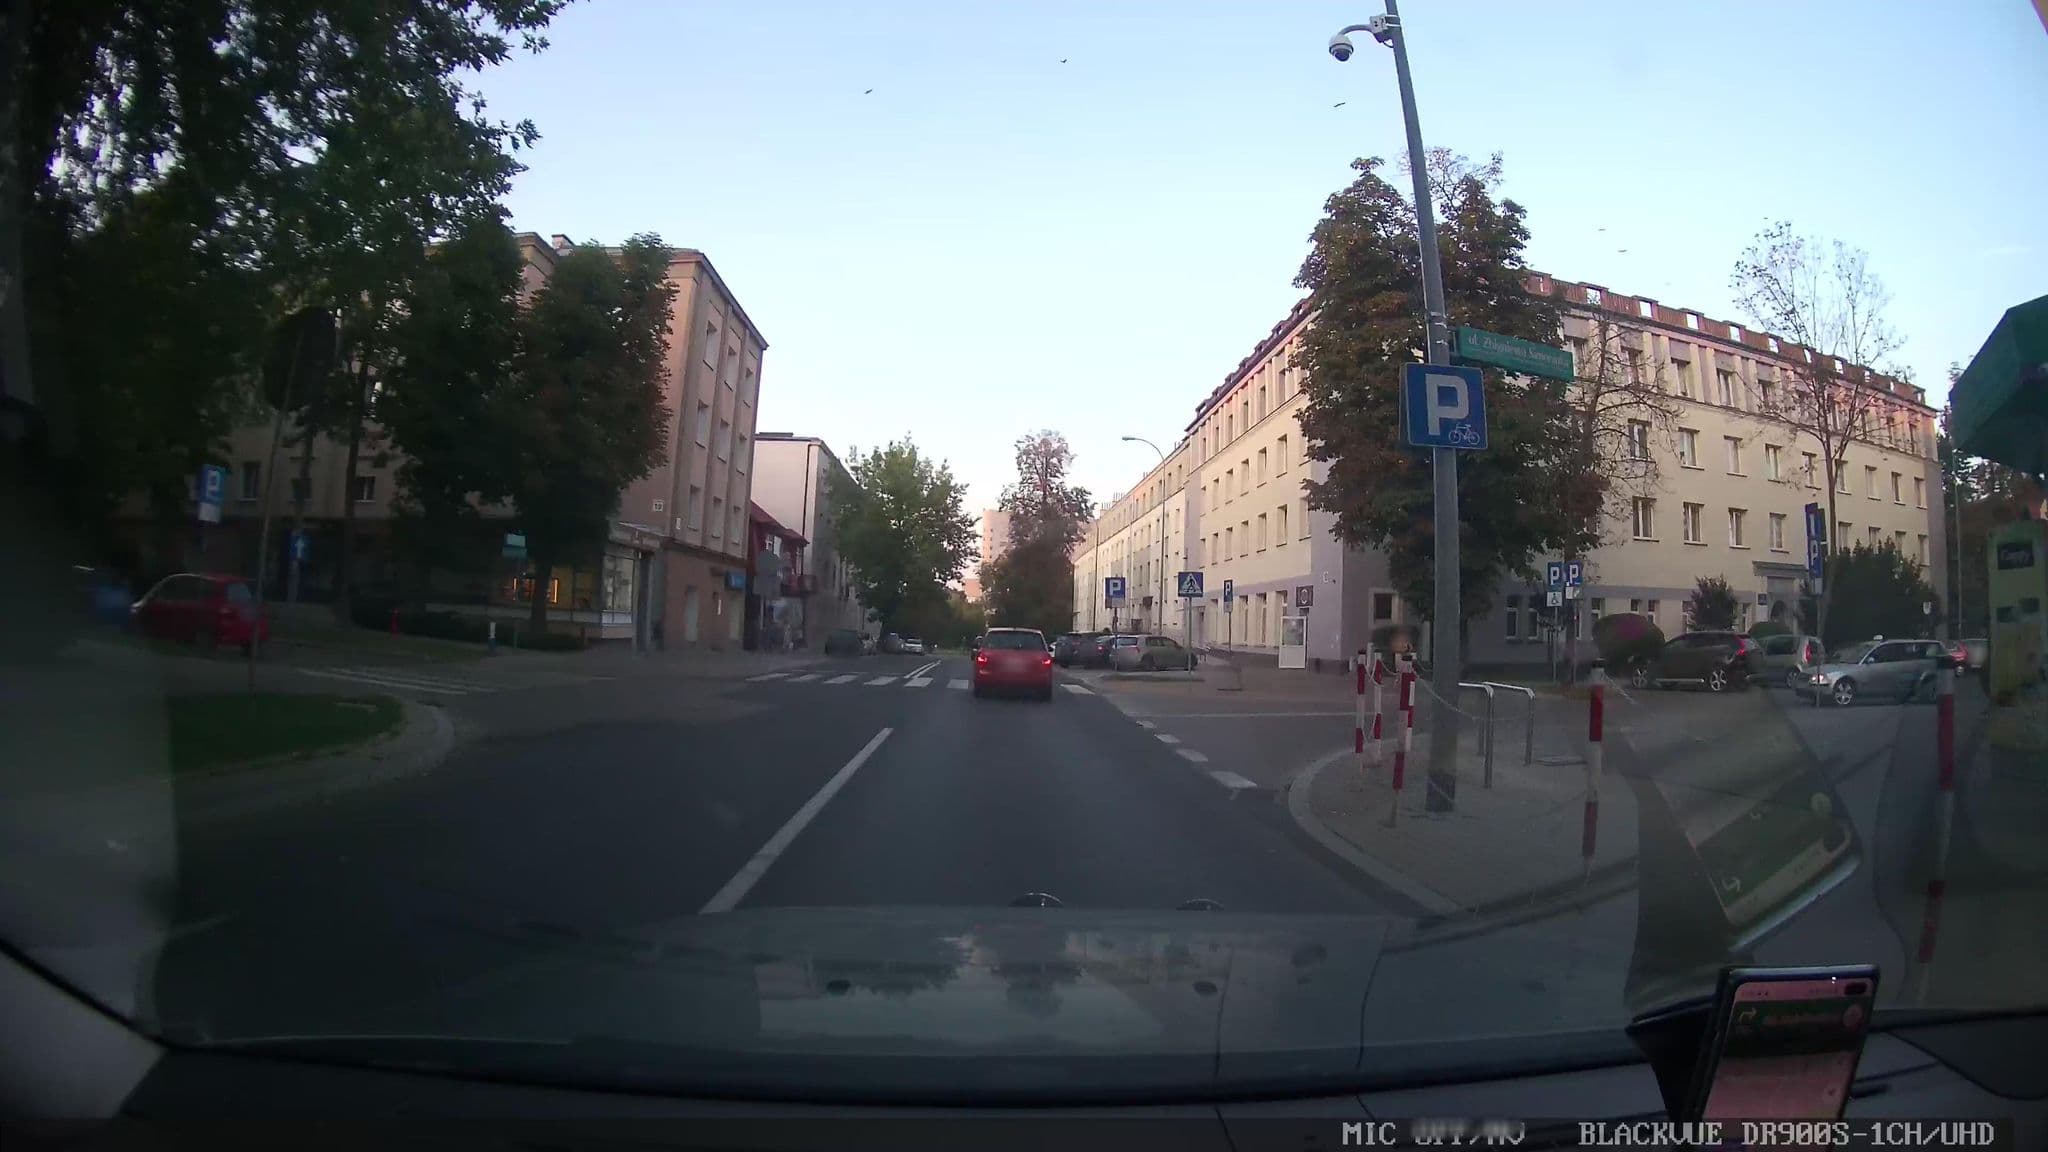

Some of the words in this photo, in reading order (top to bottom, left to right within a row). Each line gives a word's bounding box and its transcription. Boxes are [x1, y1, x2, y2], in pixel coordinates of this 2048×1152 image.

[1425, 373, 1469, 436] P
[1550, 566, 1560, 586] P
[1569, 564, 1579, 585] P
[1109, 580, 1122, 596] P
